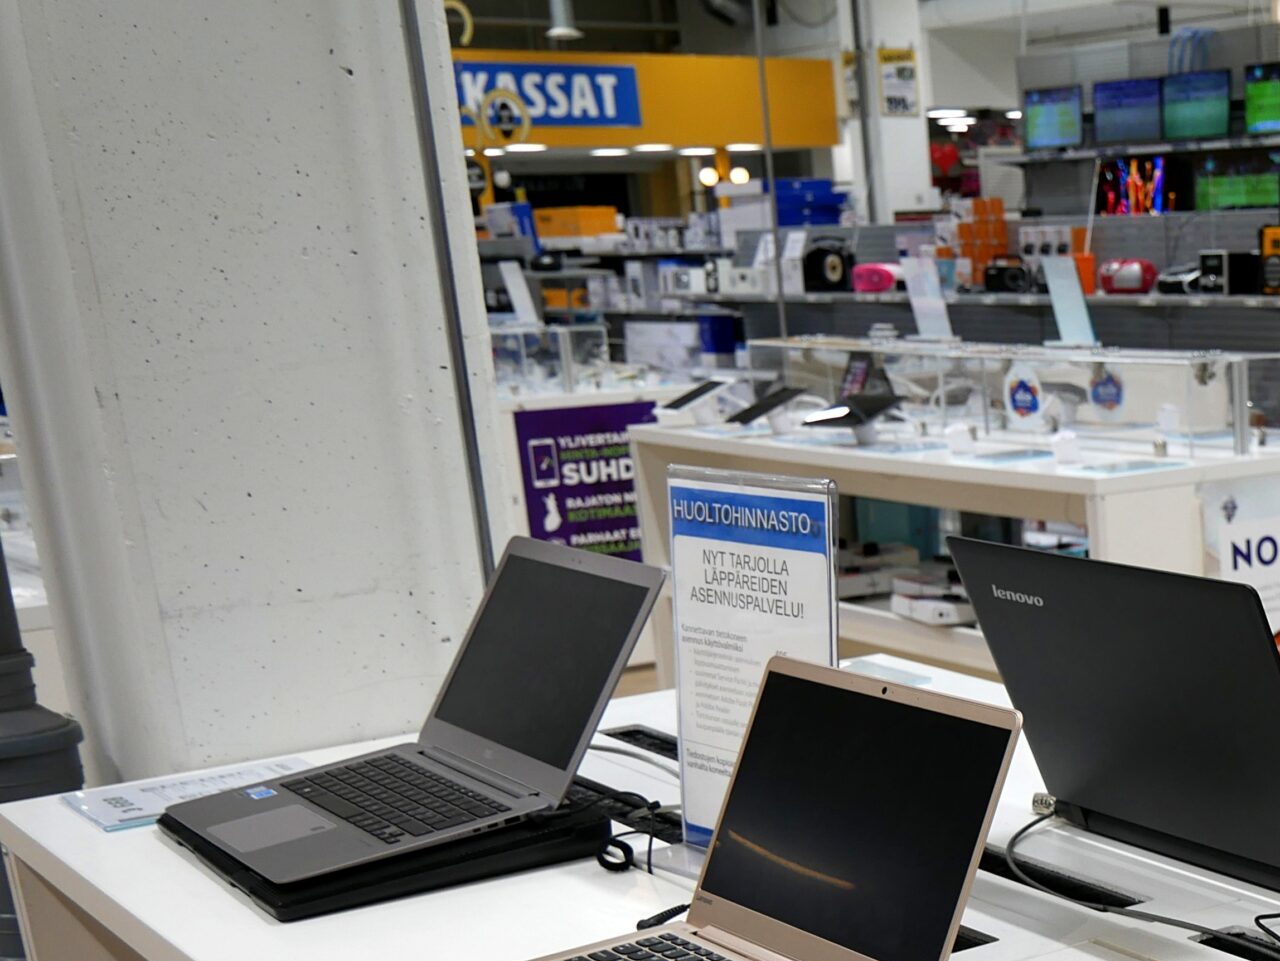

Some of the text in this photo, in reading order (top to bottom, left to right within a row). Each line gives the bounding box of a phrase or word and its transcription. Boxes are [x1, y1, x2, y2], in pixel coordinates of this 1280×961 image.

[460, 71, 617, 118] KASSAT
[673, 499, 810, 533] HUOLTOHINNASTO
[703, 549, 789, 576] NYT TARJOLLA
[705, 570, 788, 596] LÄPPÄREIDEN
[991, 584, 1044, 607] lenovo
[691, 586, 804, 619] ASENNUSPALVELU!
